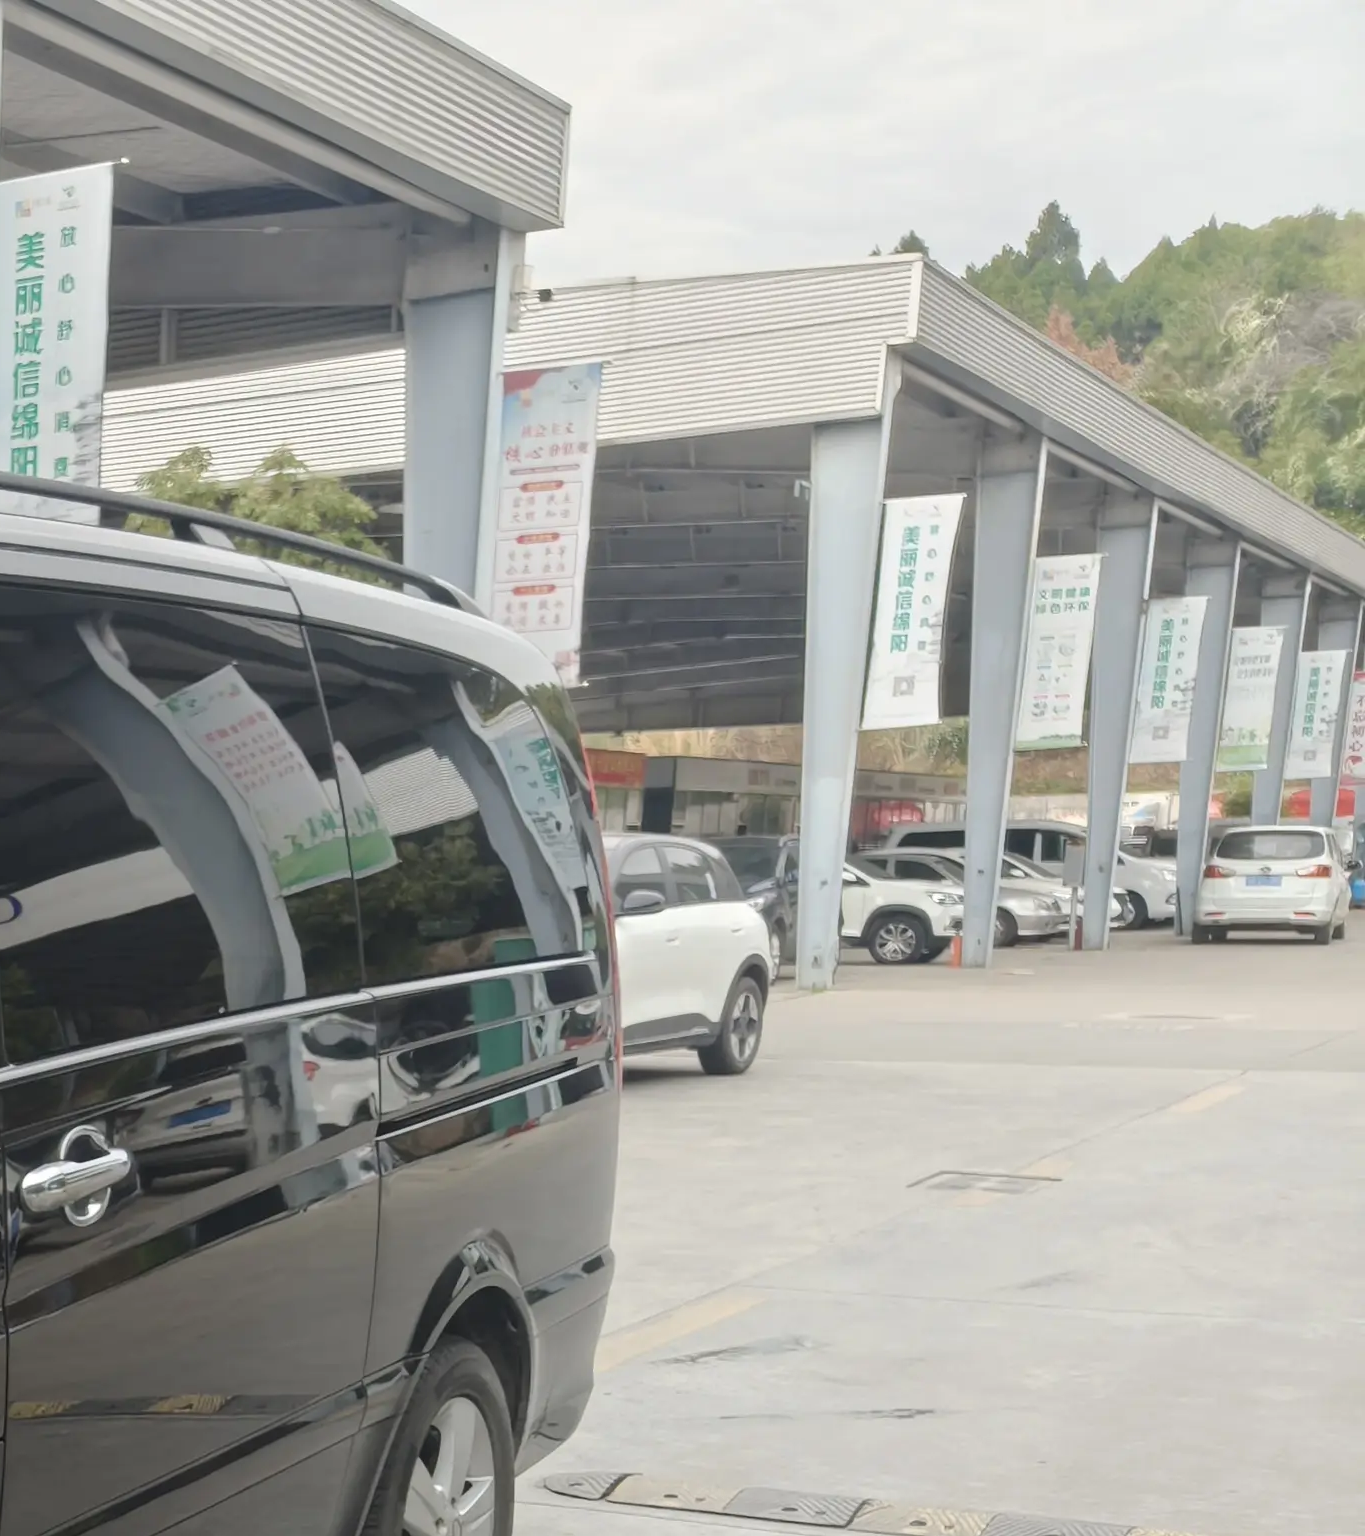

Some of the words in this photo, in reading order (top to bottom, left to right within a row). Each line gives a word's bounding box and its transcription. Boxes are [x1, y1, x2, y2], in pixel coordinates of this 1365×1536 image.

[11, 231, 45, 478] 美丽诚信绵阳
